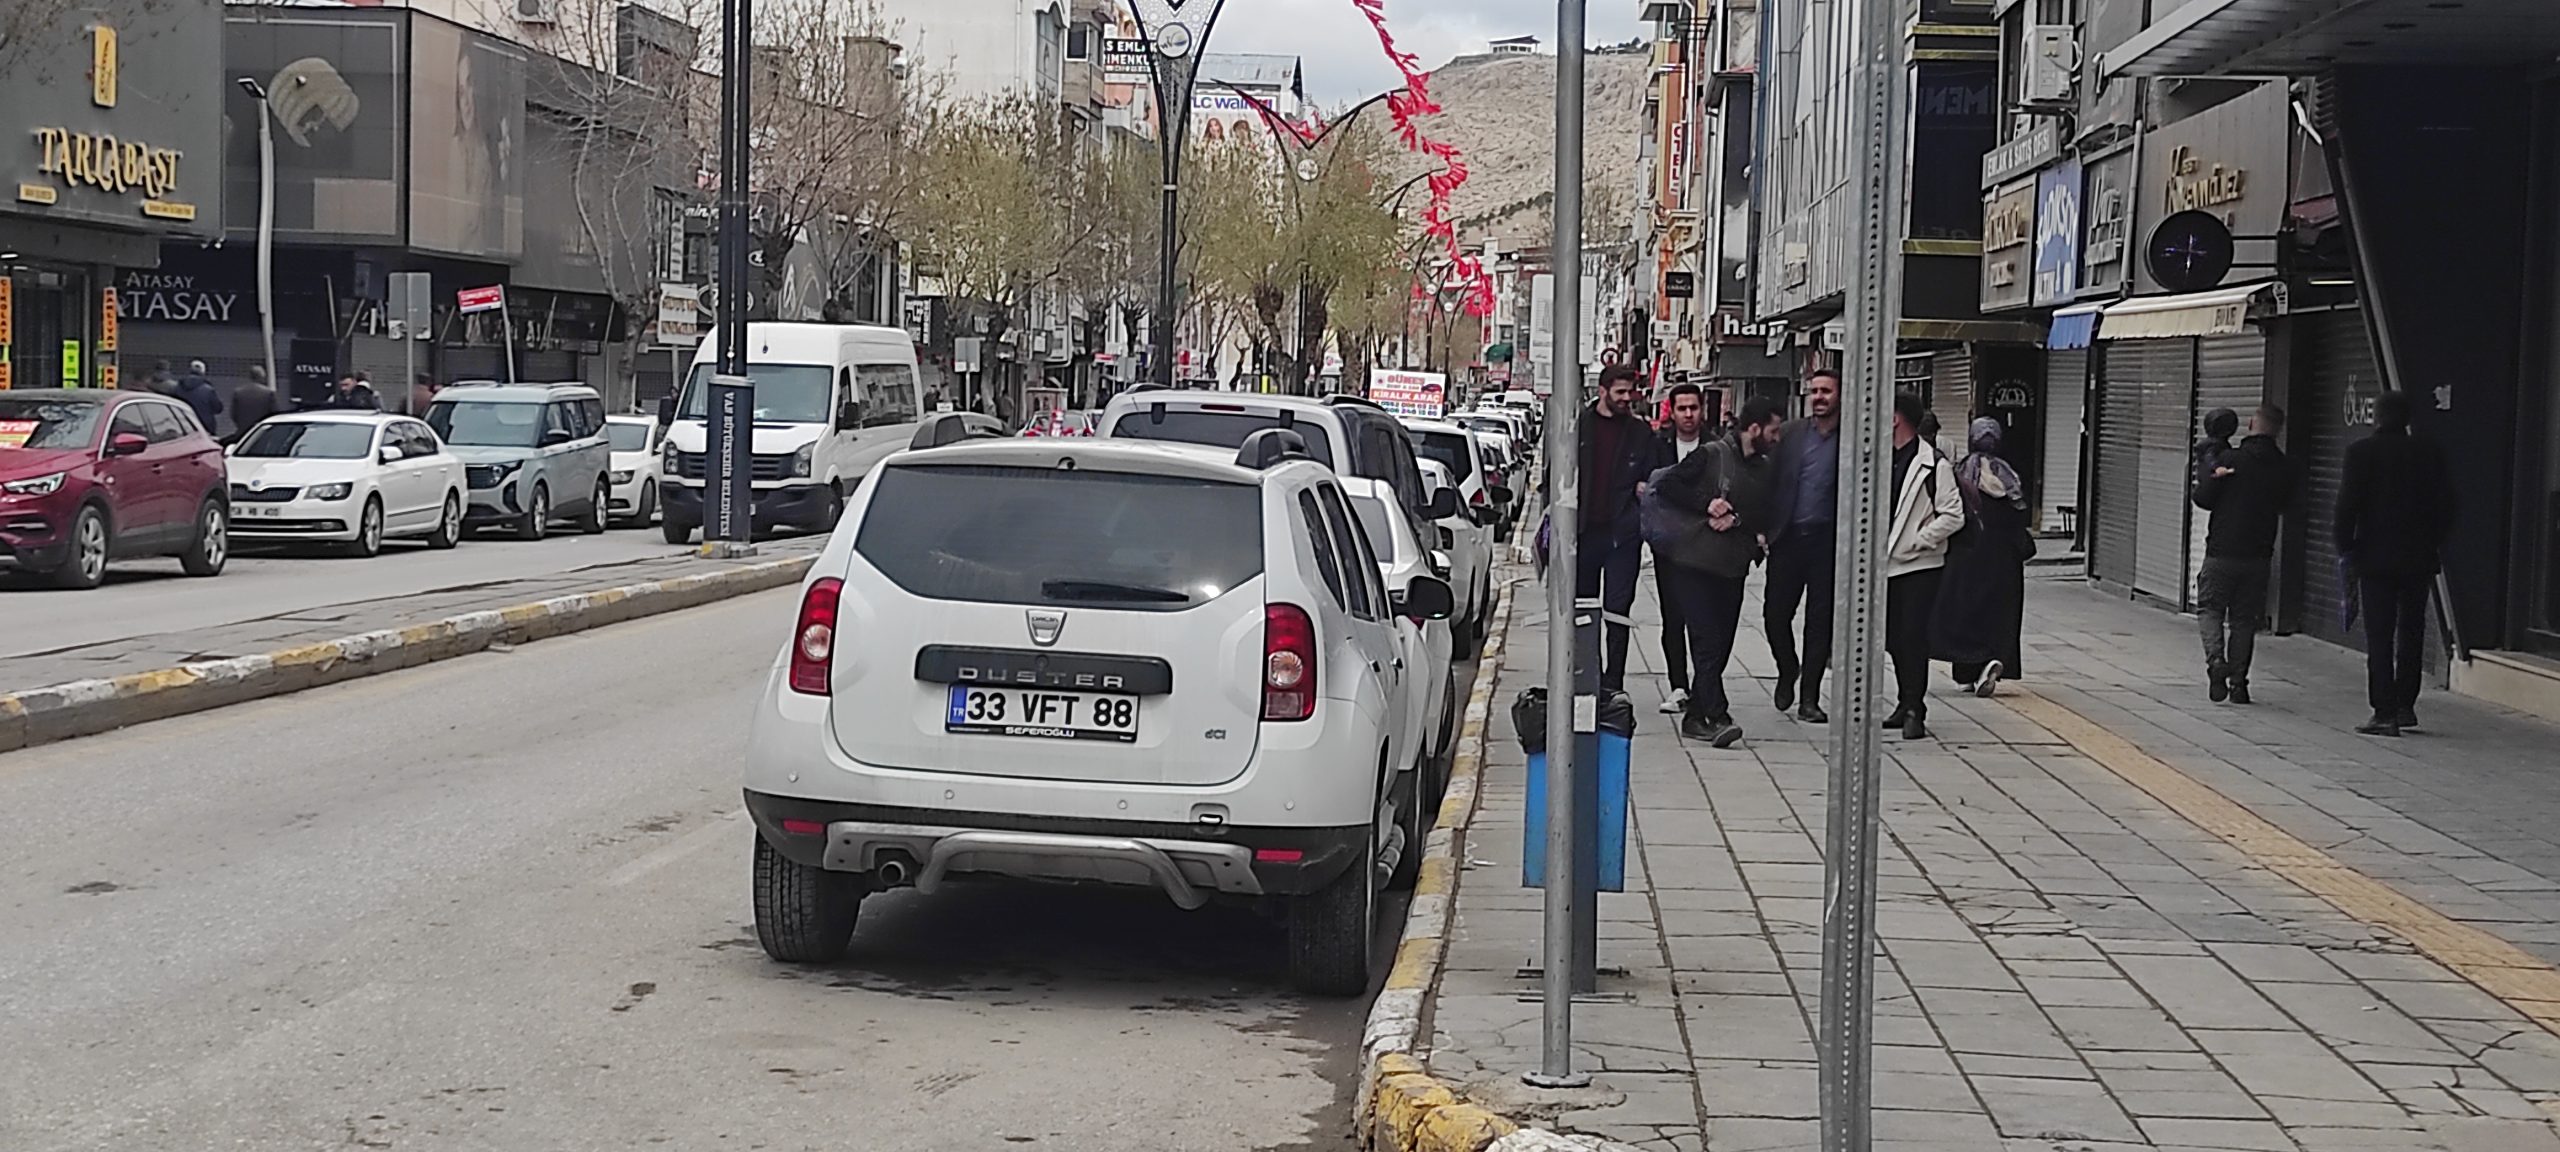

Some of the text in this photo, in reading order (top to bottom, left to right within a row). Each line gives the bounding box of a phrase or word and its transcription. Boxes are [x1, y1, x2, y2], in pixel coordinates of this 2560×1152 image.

[38, 126, 184, 198] TARLABAŞI
[126, 272, 195, 288] ATASAY
[115, 291, 237, 321] ATASAY
[296, 364, 332, 374] ATASAY
[1373, 390, 1412, 401] KİRALIK
[719, 392, 735, 536] VAN BÜYÜKŞEHİR BELEDİYESİ
[958, 667, 1123, 689] DUSTER
[953, 691, 1133, 728] TR 33 VFT 88
[1005, 726, 1075, 738] SEFEROĞLU
